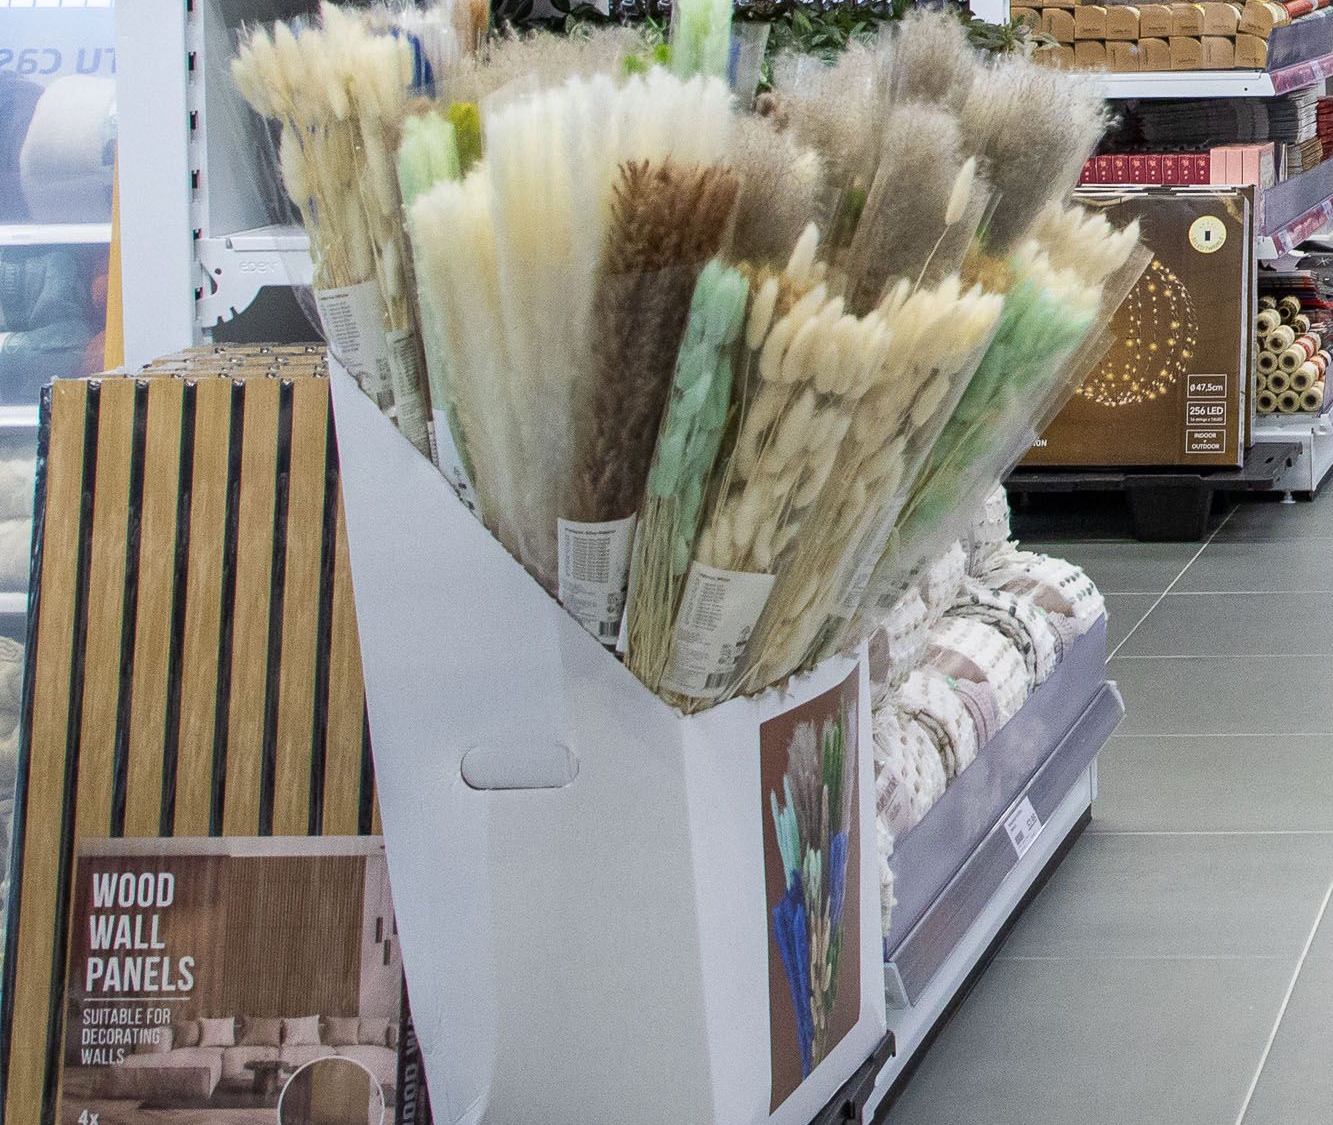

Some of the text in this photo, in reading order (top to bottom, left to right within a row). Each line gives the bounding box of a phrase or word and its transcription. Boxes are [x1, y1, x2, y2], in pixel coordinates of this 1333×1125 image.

[1190, 406, 1224, 415] 256 LED
[92, 872, 176, 909] WOOD
[89, 914, 165, 950] WALL
[85, 955, 195, 993] PANELS
[82, 1007, 171, 1025] SUITABLE FOR
[81, 1027, 161, 1045] DECORATING
[81, 1048, 125, 1065] WALLS
[78, 1109, 99, 1125] 4x
